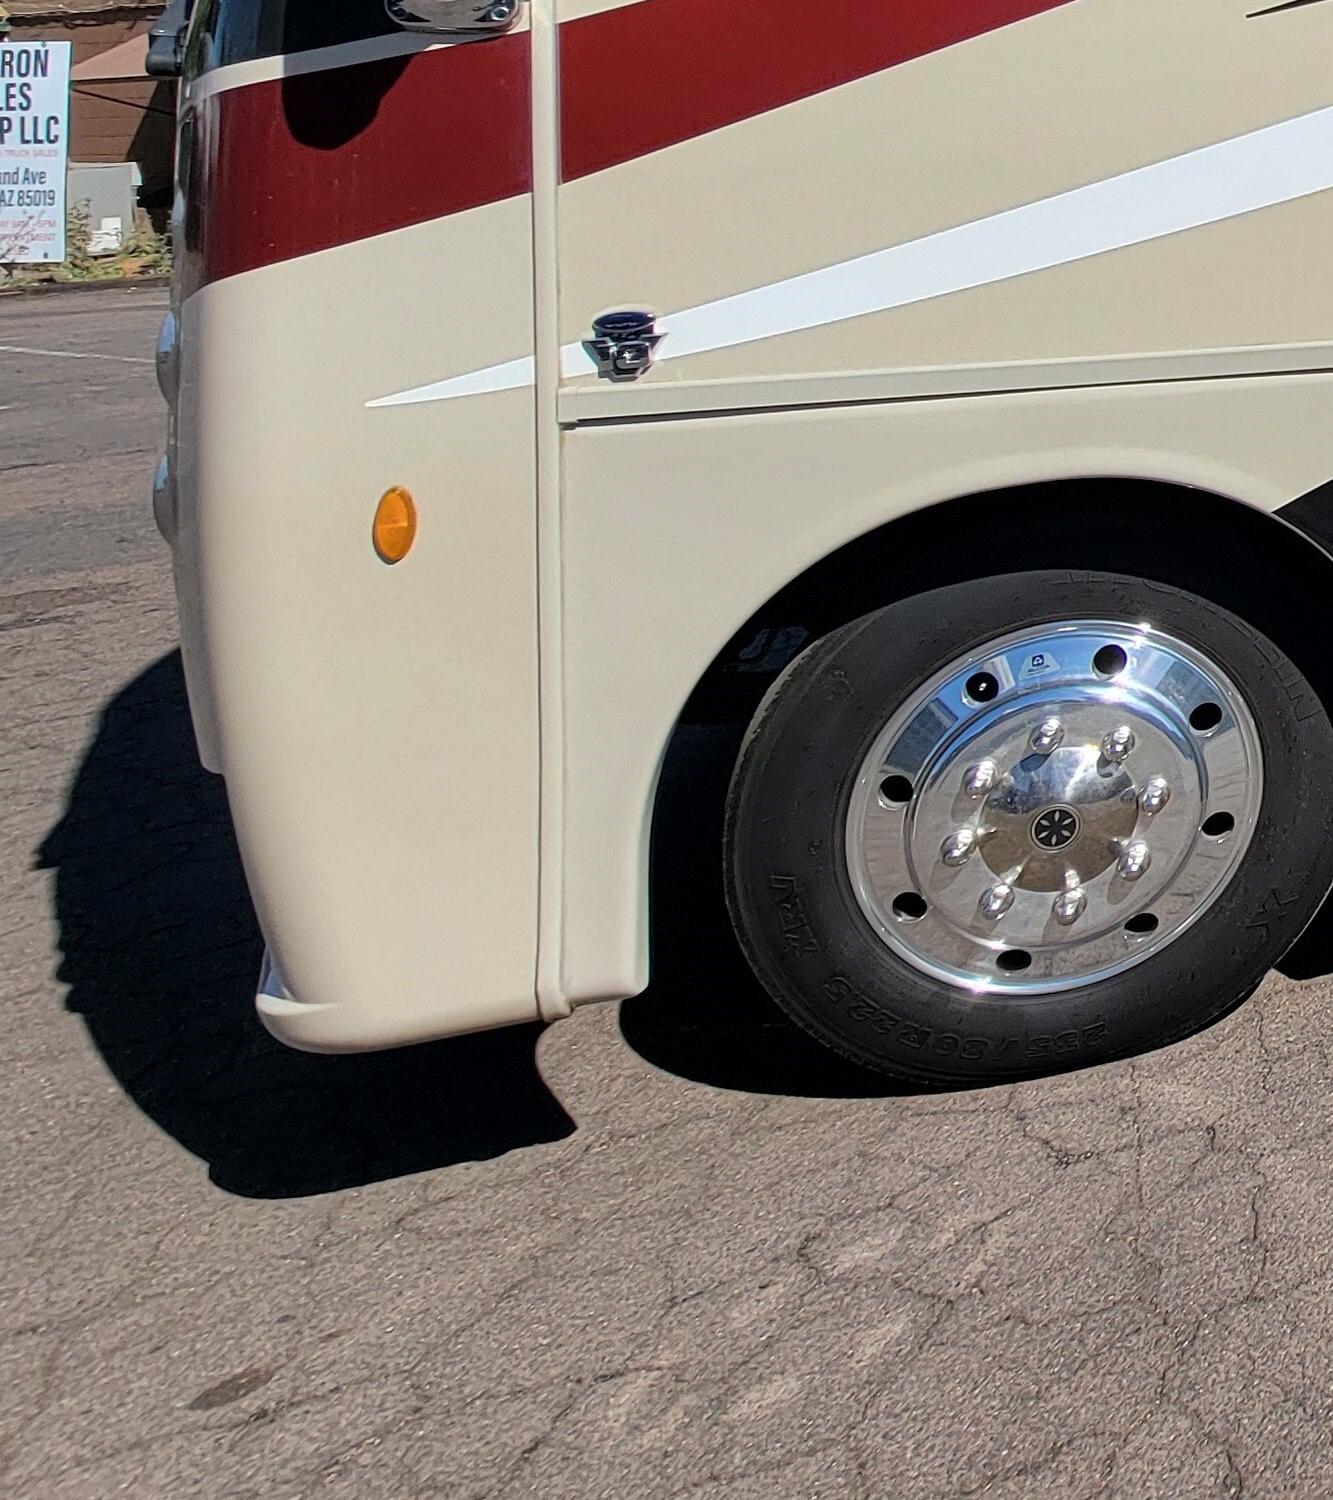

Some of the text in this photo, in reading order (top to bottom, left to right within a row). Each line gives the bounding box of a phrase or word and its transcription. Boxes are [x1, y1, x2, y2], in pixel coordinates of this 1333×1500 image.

[1, 49, 49, 78] RON
[20, 115, 59, 145] LLC
[22, 167, 46, 185] Ave
[17, 189, 56, 207] 85019
